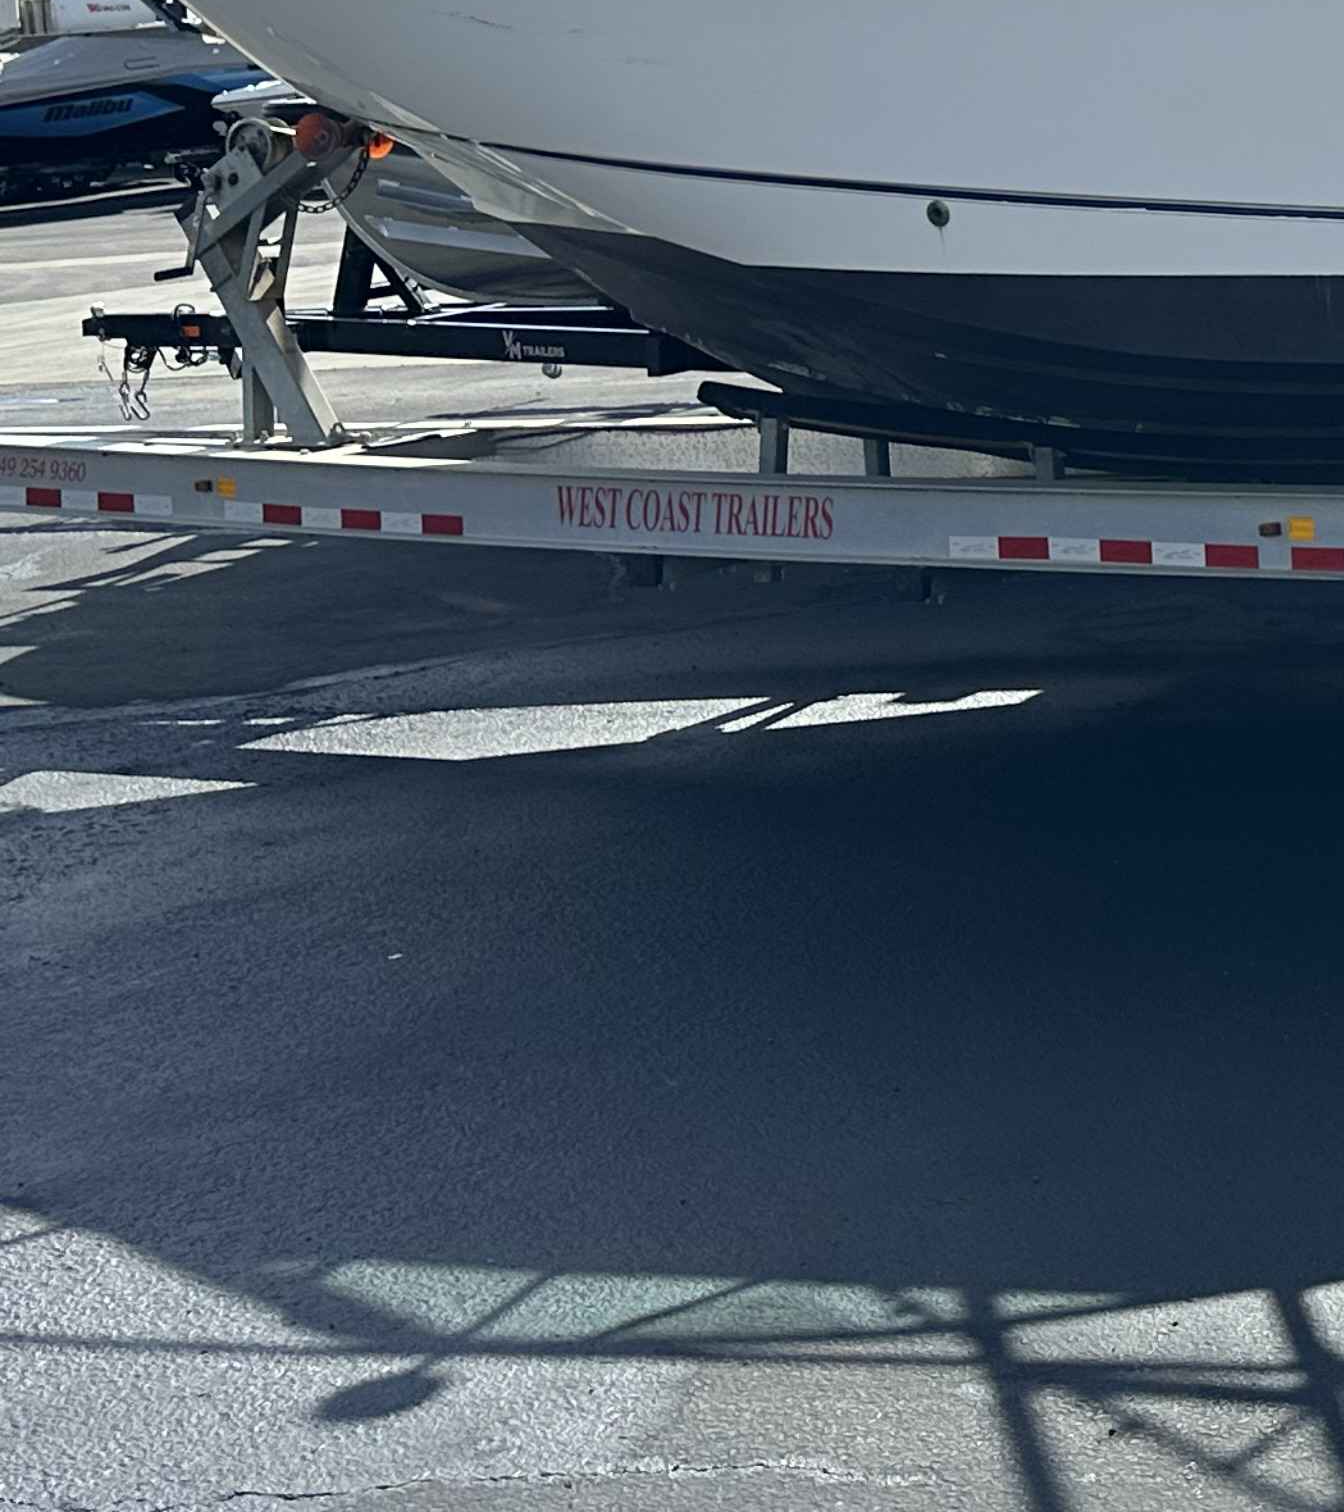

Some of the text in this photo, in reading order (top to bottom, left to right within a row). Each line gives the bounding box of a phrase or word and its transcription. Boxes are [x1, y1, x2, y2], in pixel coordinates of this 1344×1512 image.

[43, 98, 134, 122] Malibu
[523, 345, 565, 358] TRAILERS
[20, 457, 46, 479] 254
[50, 460, 87, 482] 9360
[557, 485, 834, 540] WEST COAST TRAILERS
